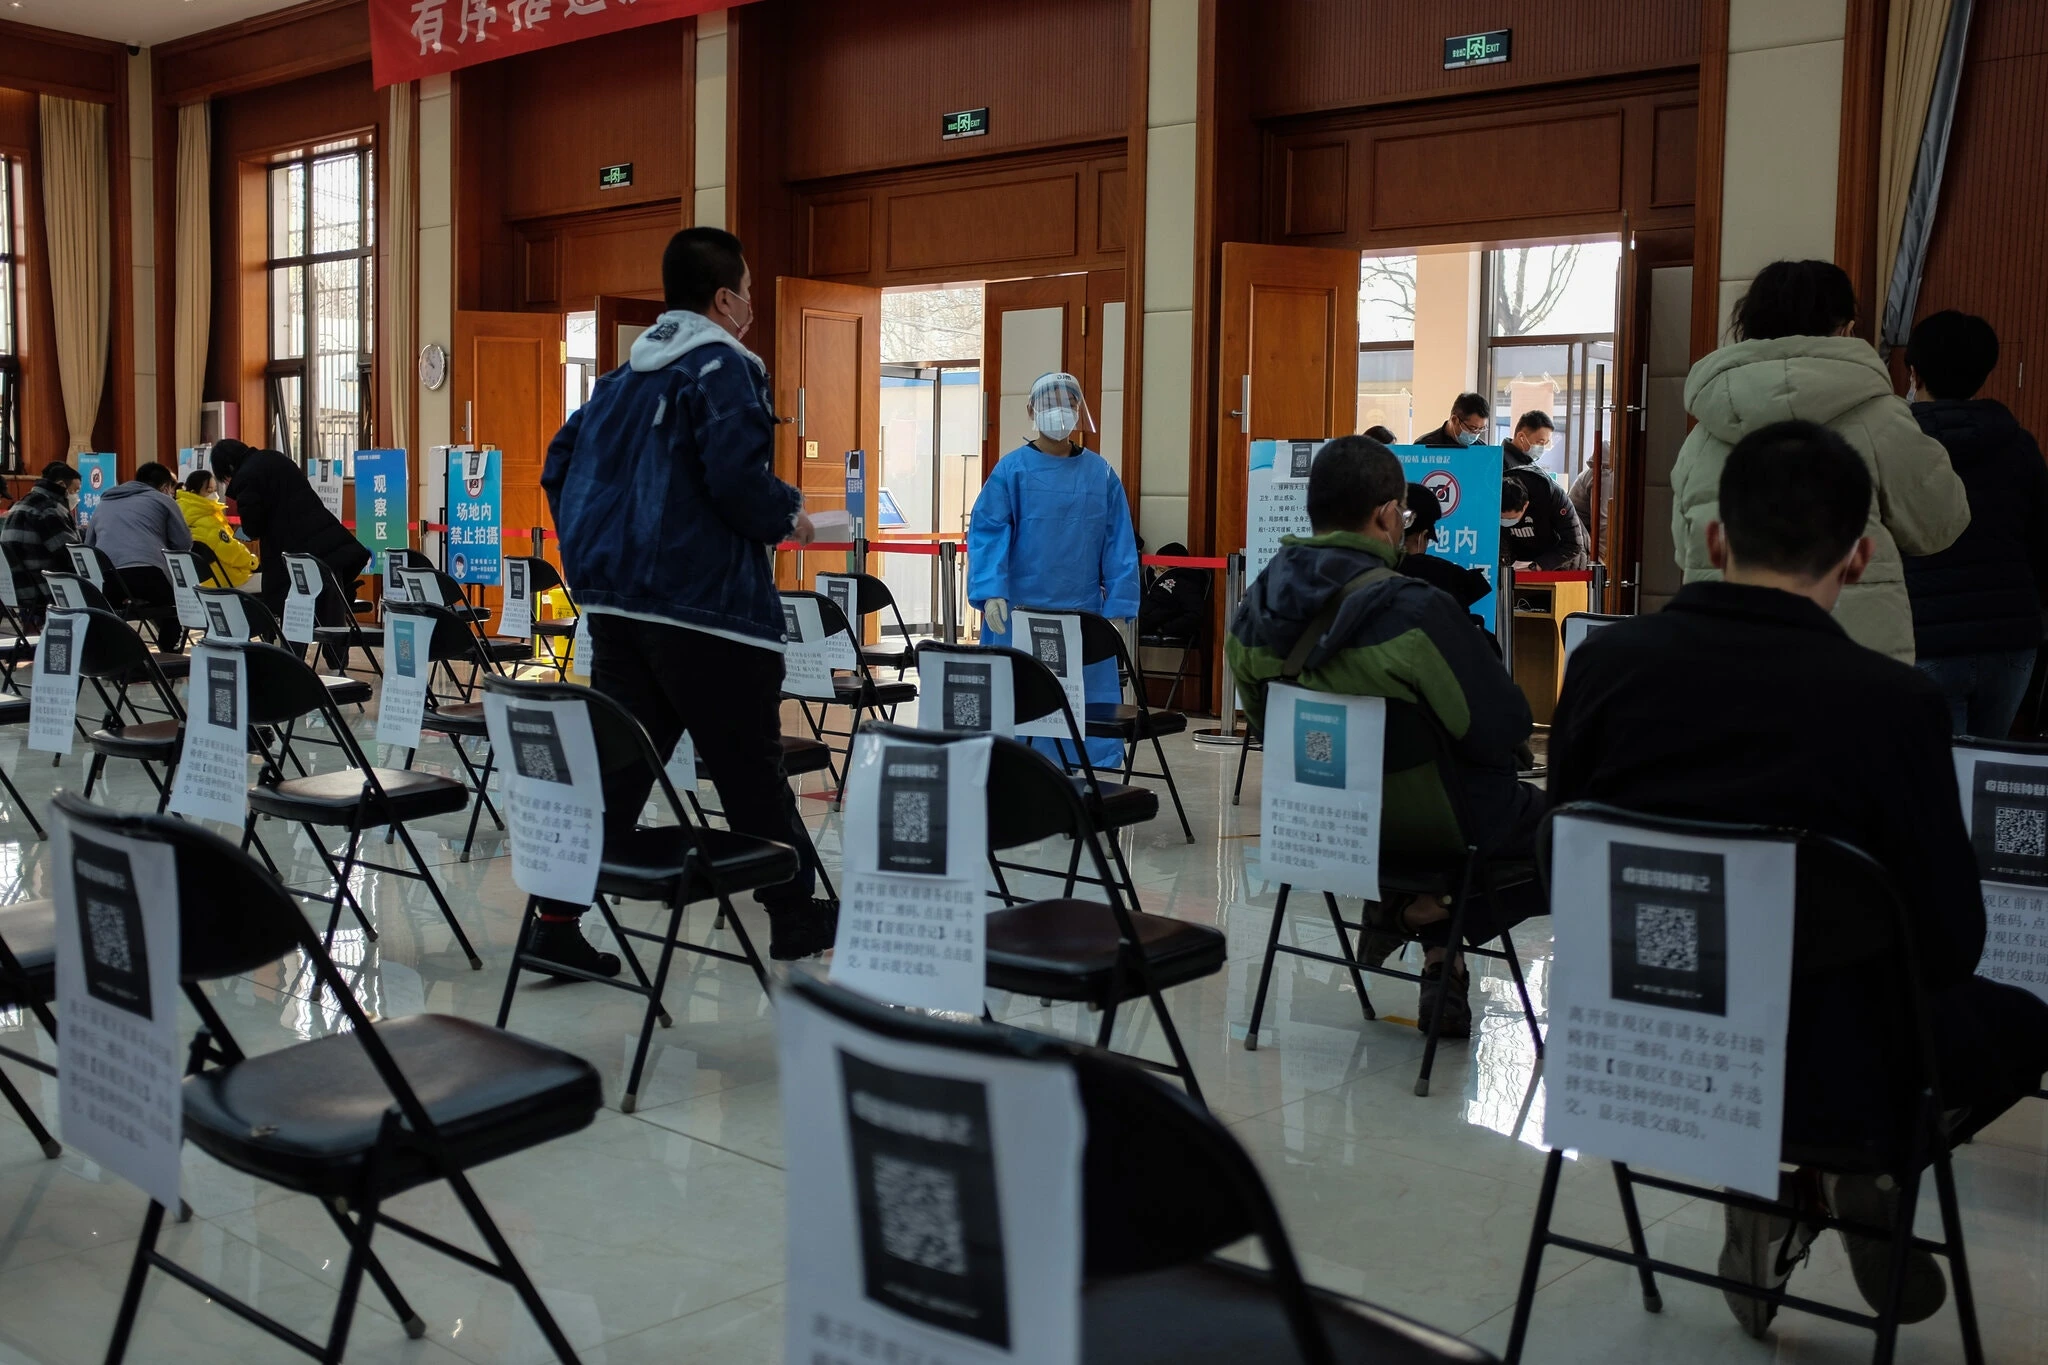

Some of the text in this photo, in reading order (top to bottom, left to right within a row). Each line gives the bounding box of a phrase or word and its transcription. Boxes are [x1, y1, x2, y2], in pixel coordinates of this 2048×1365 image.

[1486, 43, 1500, 53] EXIT
[971, 119, 980, 127] EXIT
[374, 474, 387, 540] 观察区
[456, 503, 492, 521] 场地内
[451, 526, 499, 545] 禁止拍摄
[1985, 780, 2048, 796] 疫苗接种登
[1984, 895, 2048, 912] 观区前请
